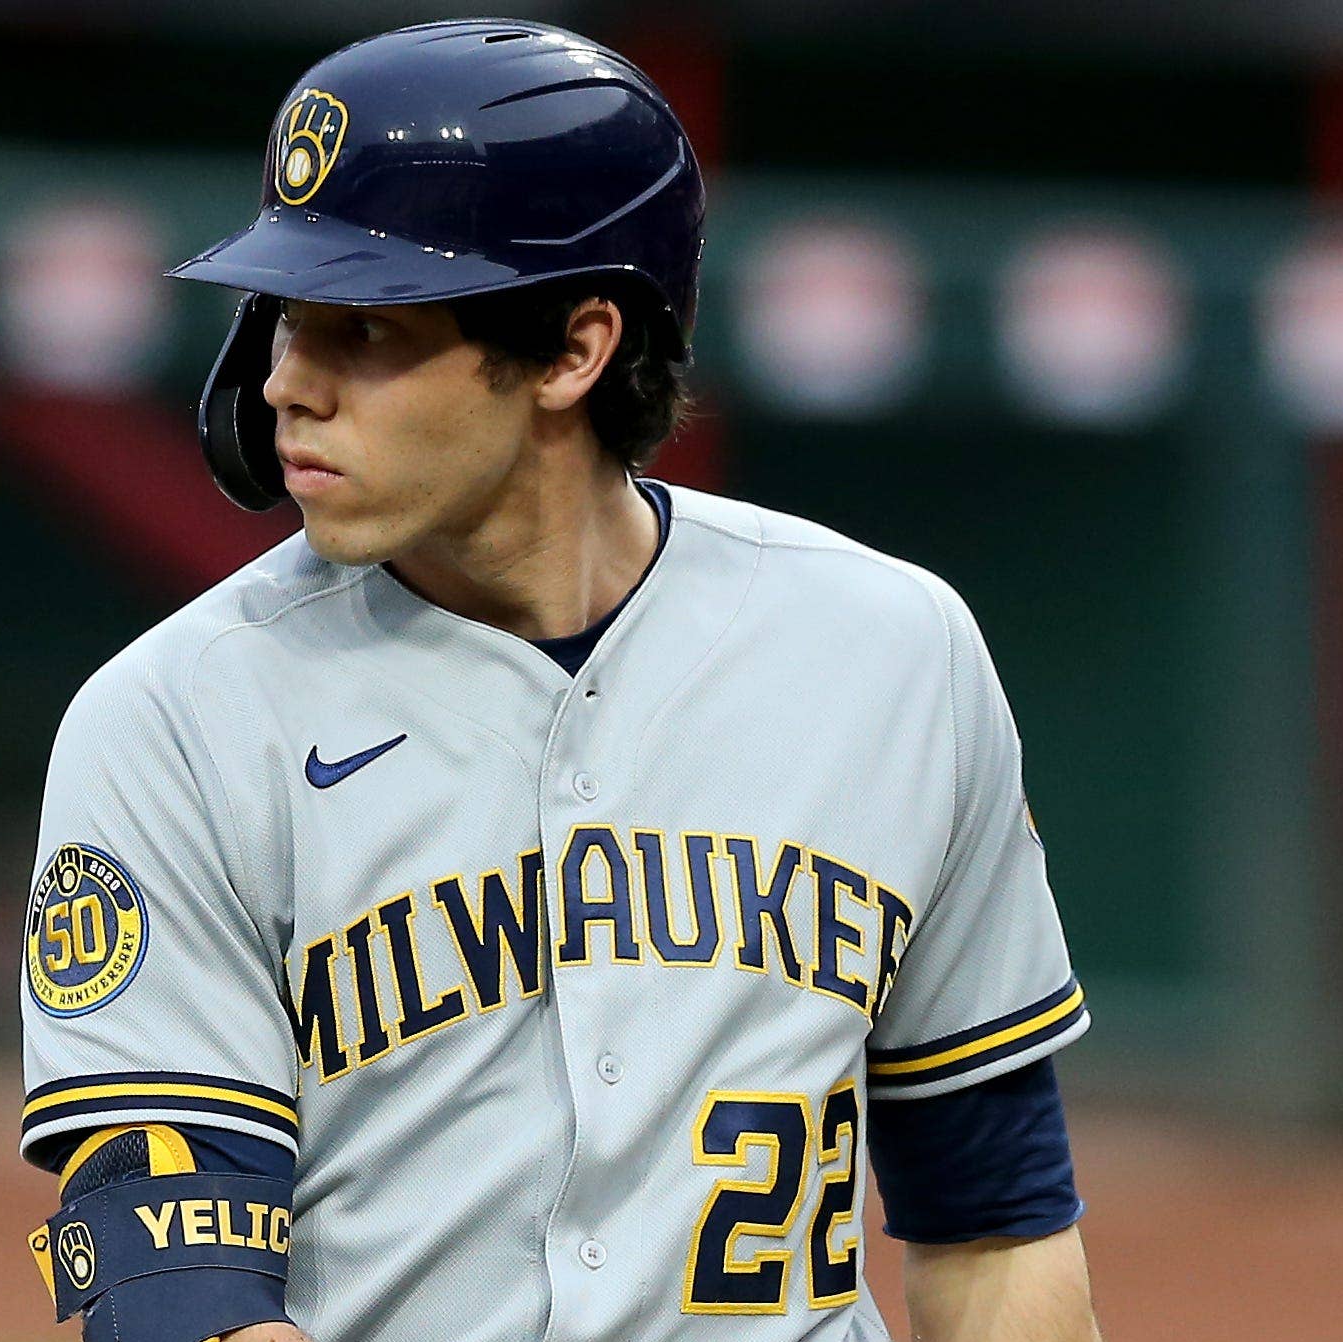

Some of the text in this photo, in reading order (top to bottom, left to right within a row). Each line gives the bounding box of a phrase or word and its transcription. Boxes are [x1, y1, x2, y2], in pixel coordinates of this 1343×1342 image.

[89, 860, 121, 892] 2020
[45, 893, 107, 973] 50
[58, 931, 135, 1005] ANNIVERSARY
[133, 1199, 294, 1257] YELIC
[681, 1076, 859, 1315] 22
